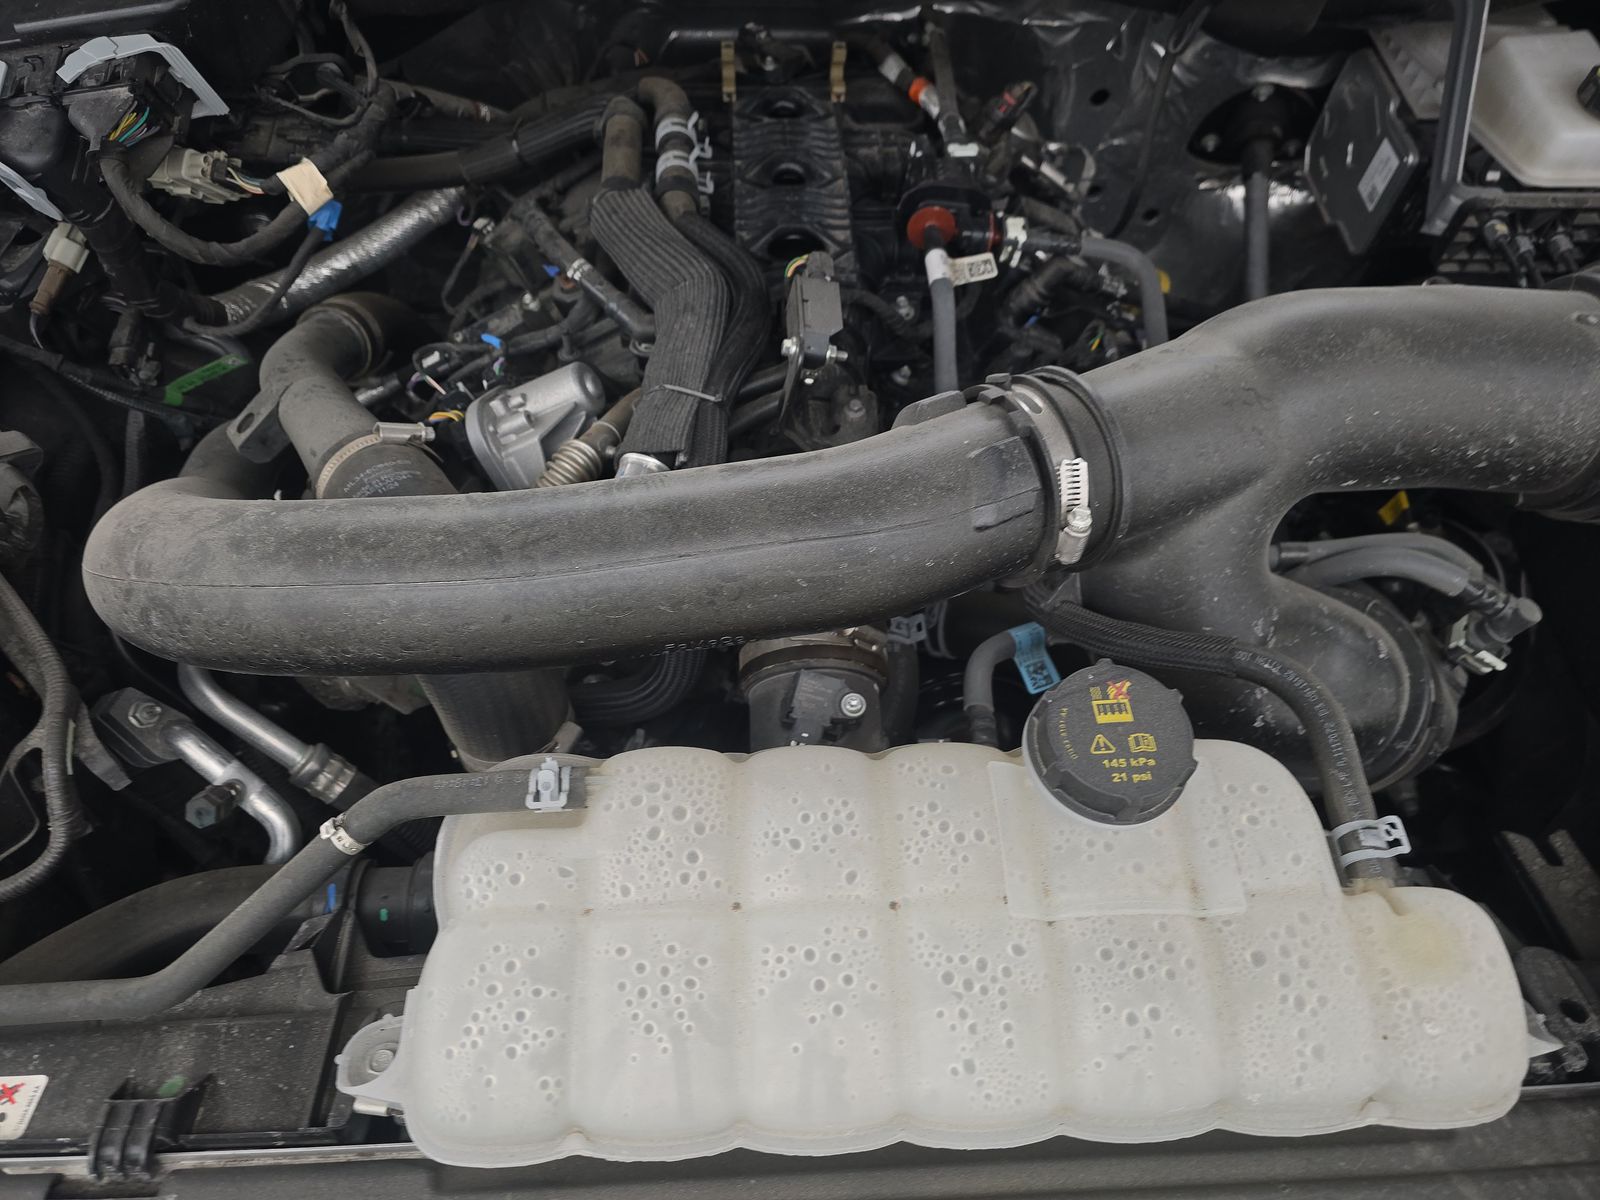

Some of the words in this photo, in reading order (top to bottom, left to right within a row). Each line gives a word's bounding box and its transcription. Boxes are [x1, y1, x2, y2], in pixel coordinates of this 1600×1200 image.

[1102, 758, 1127, 768] 145
[1130, 757, 1156, 767] kPa
[1111, 772, 1128, 783] 21
[1131, 771, 1153, 783] psi
